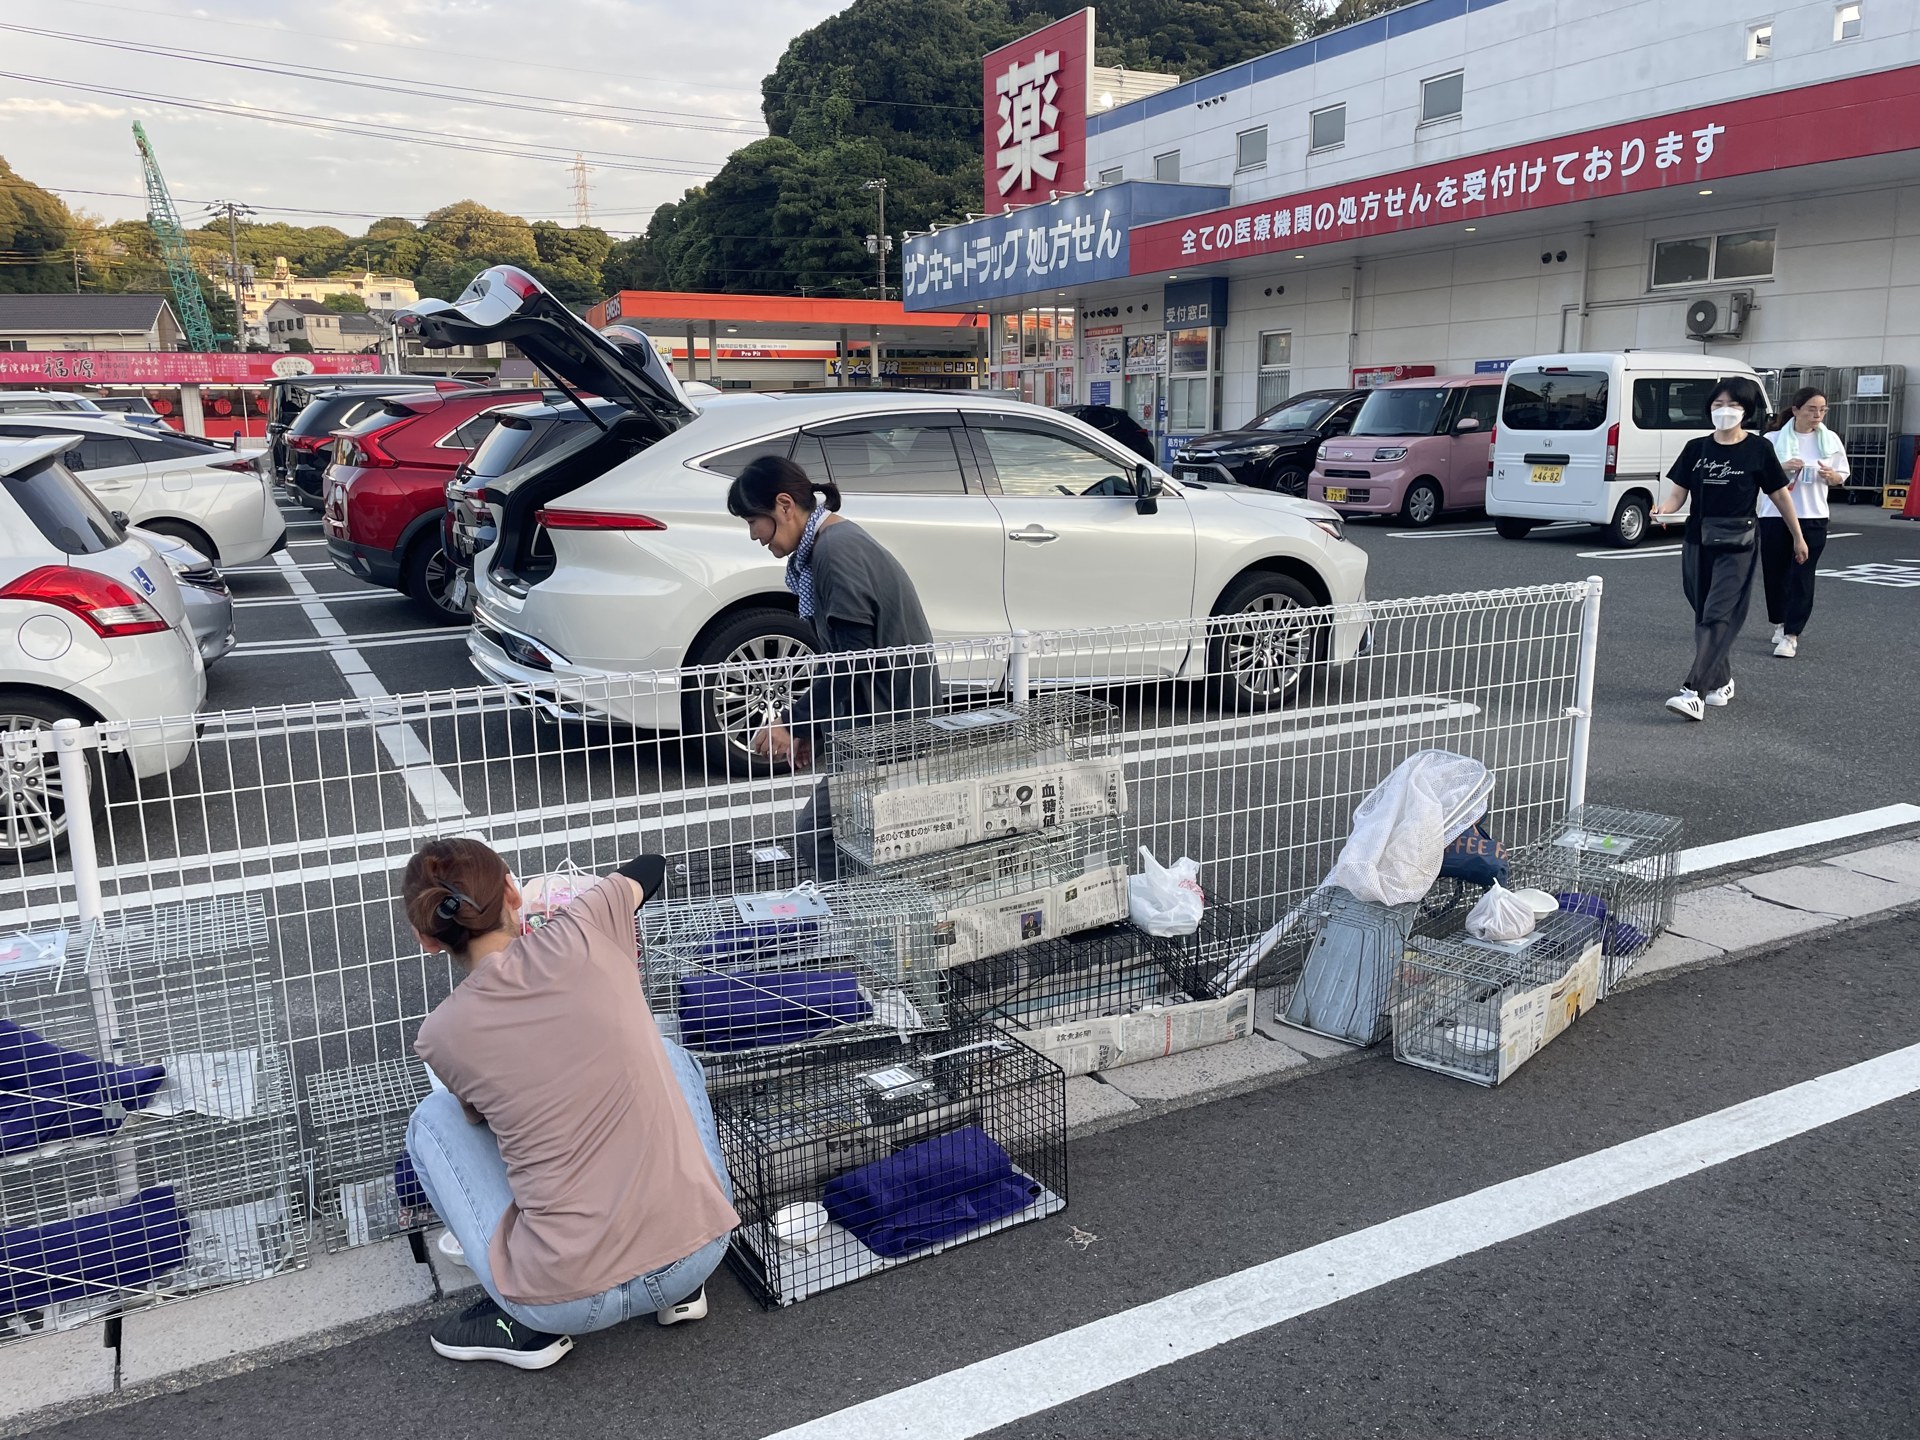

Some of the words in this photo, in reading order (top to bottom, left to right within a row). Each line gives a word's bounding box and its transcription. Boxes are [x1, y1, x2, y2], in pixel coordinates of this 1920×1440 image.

[996, 49, 1061, 196] 薬
[1181, 122, 1726, 256] 全ての医療機関の処方せんを受付けております
[904, 227, 1023, 299] サンキュードラッグ
[1025, 208, 1123, 276] 処方せん
[605, 297, 621, 321] ENEOS
[1166, 303, 1209, 323] 受付窓口
[43, 357, 96, 379] 福源
[1537, 472, 1560, 481] 46-82
[1041, 783, 1056, 828] 血糖値
[1446, 836, 1489, 855] FEE
